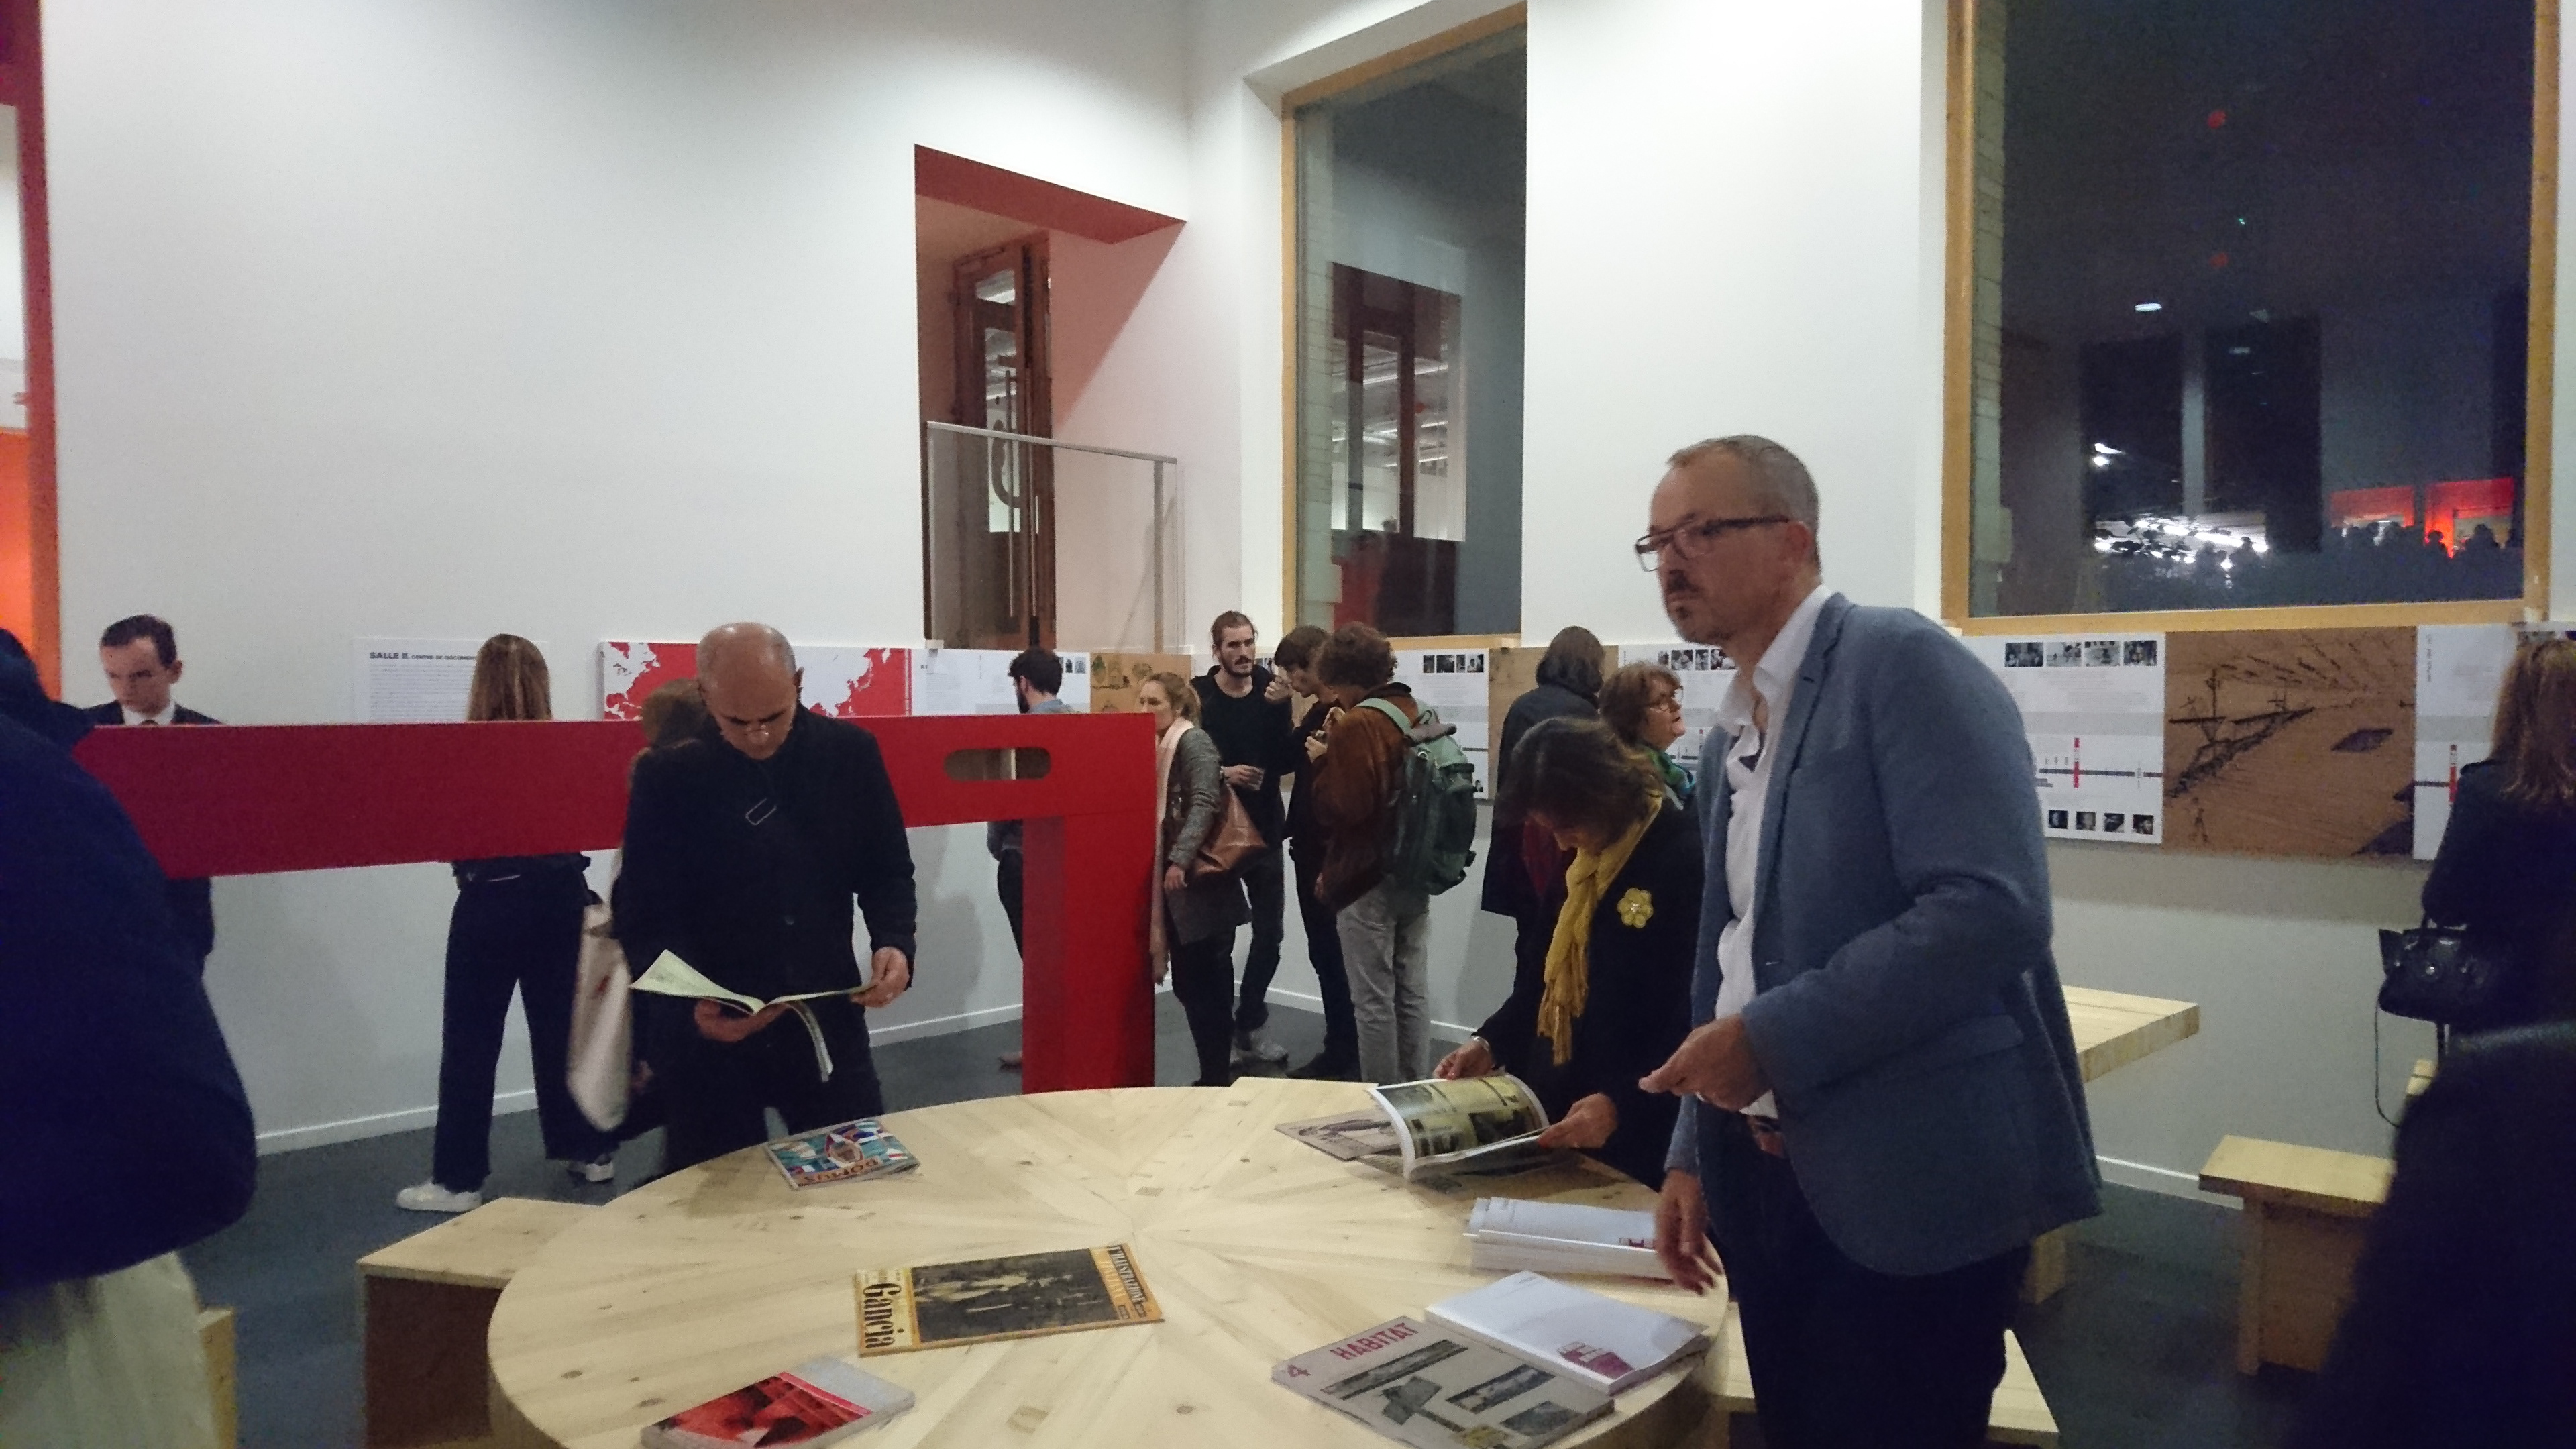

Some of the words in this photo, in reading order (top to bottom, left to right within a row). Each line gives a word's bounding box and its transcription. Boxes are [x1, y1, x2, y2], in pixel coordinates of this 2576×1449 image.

[369, 651, 400, 659] SALLE
[863, 1283, 905, 1349] Gancia
[1287, 1364, 1311, 1378] 4
[1329, 1322, 1419, 1360] HABITAT
